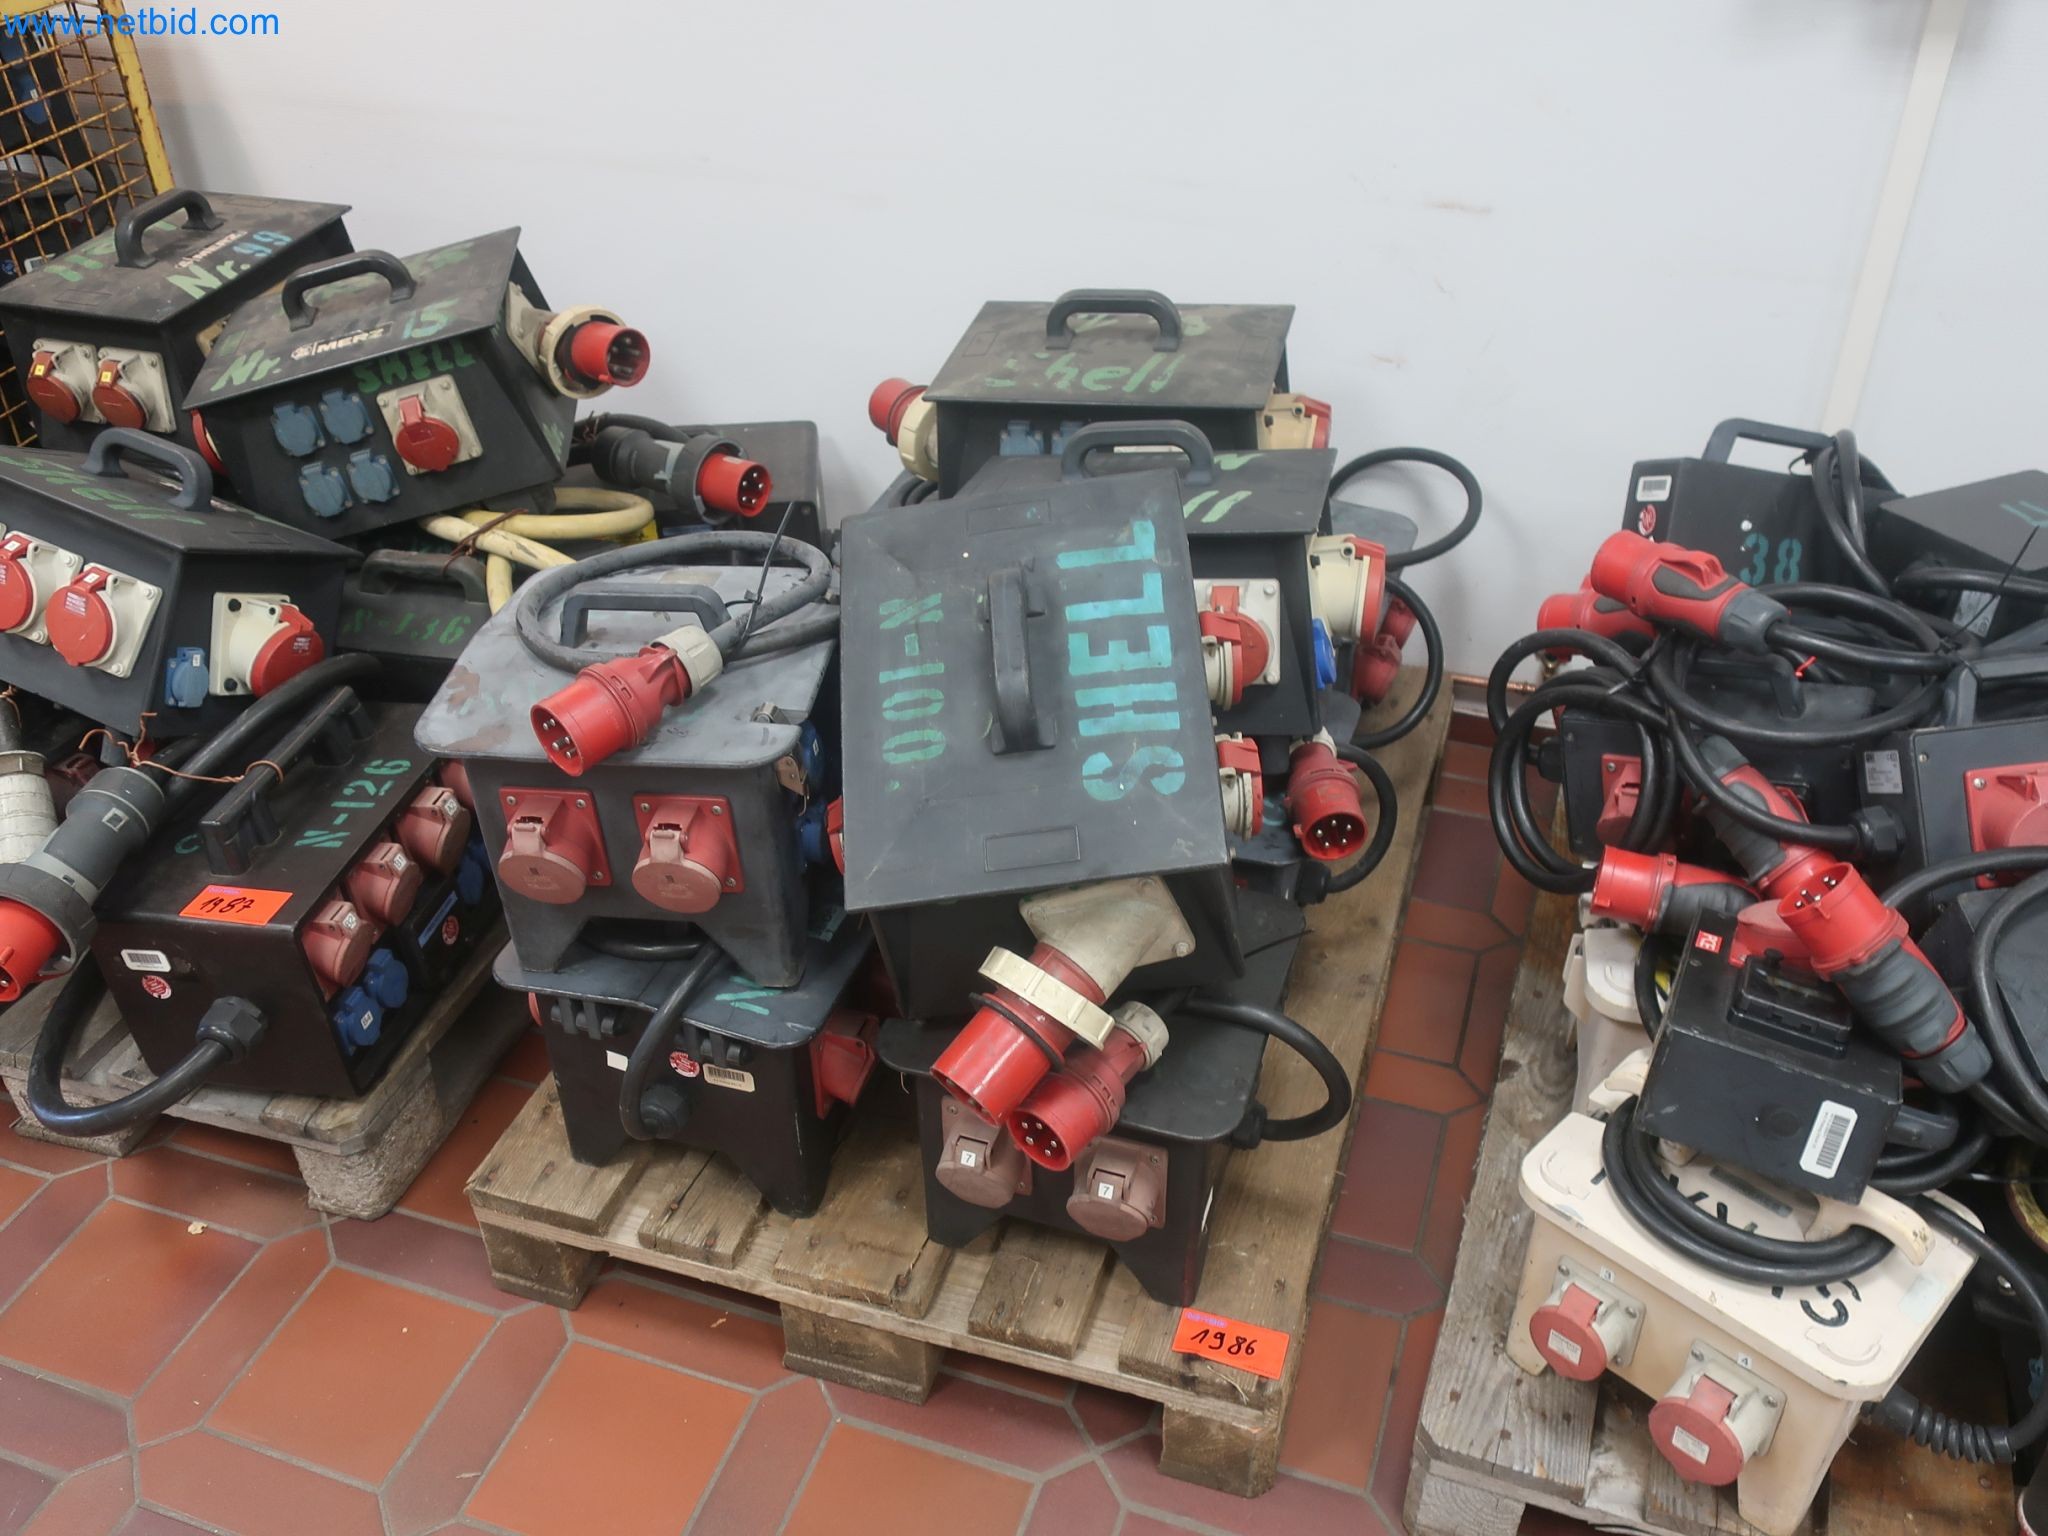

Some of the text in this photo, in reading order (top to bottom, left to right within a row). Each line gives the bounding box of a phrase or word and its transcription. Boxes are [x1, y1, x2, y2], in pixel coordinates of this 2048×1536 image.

[166, 260, 251, 300] Nr.
[316, 327, 385, 354] MERZ
[210, 351, 282, 392] Nr.
[352, 337, 477, 393] SHELL
[1739, 532, 1803, 586] 38
[1056, 518, 1187, 802] SHELL
[294, 759, 412, 848] N-126
[200, 895, 255, 914] 1987
[1190, 1328, 1258, 1356] 1986
